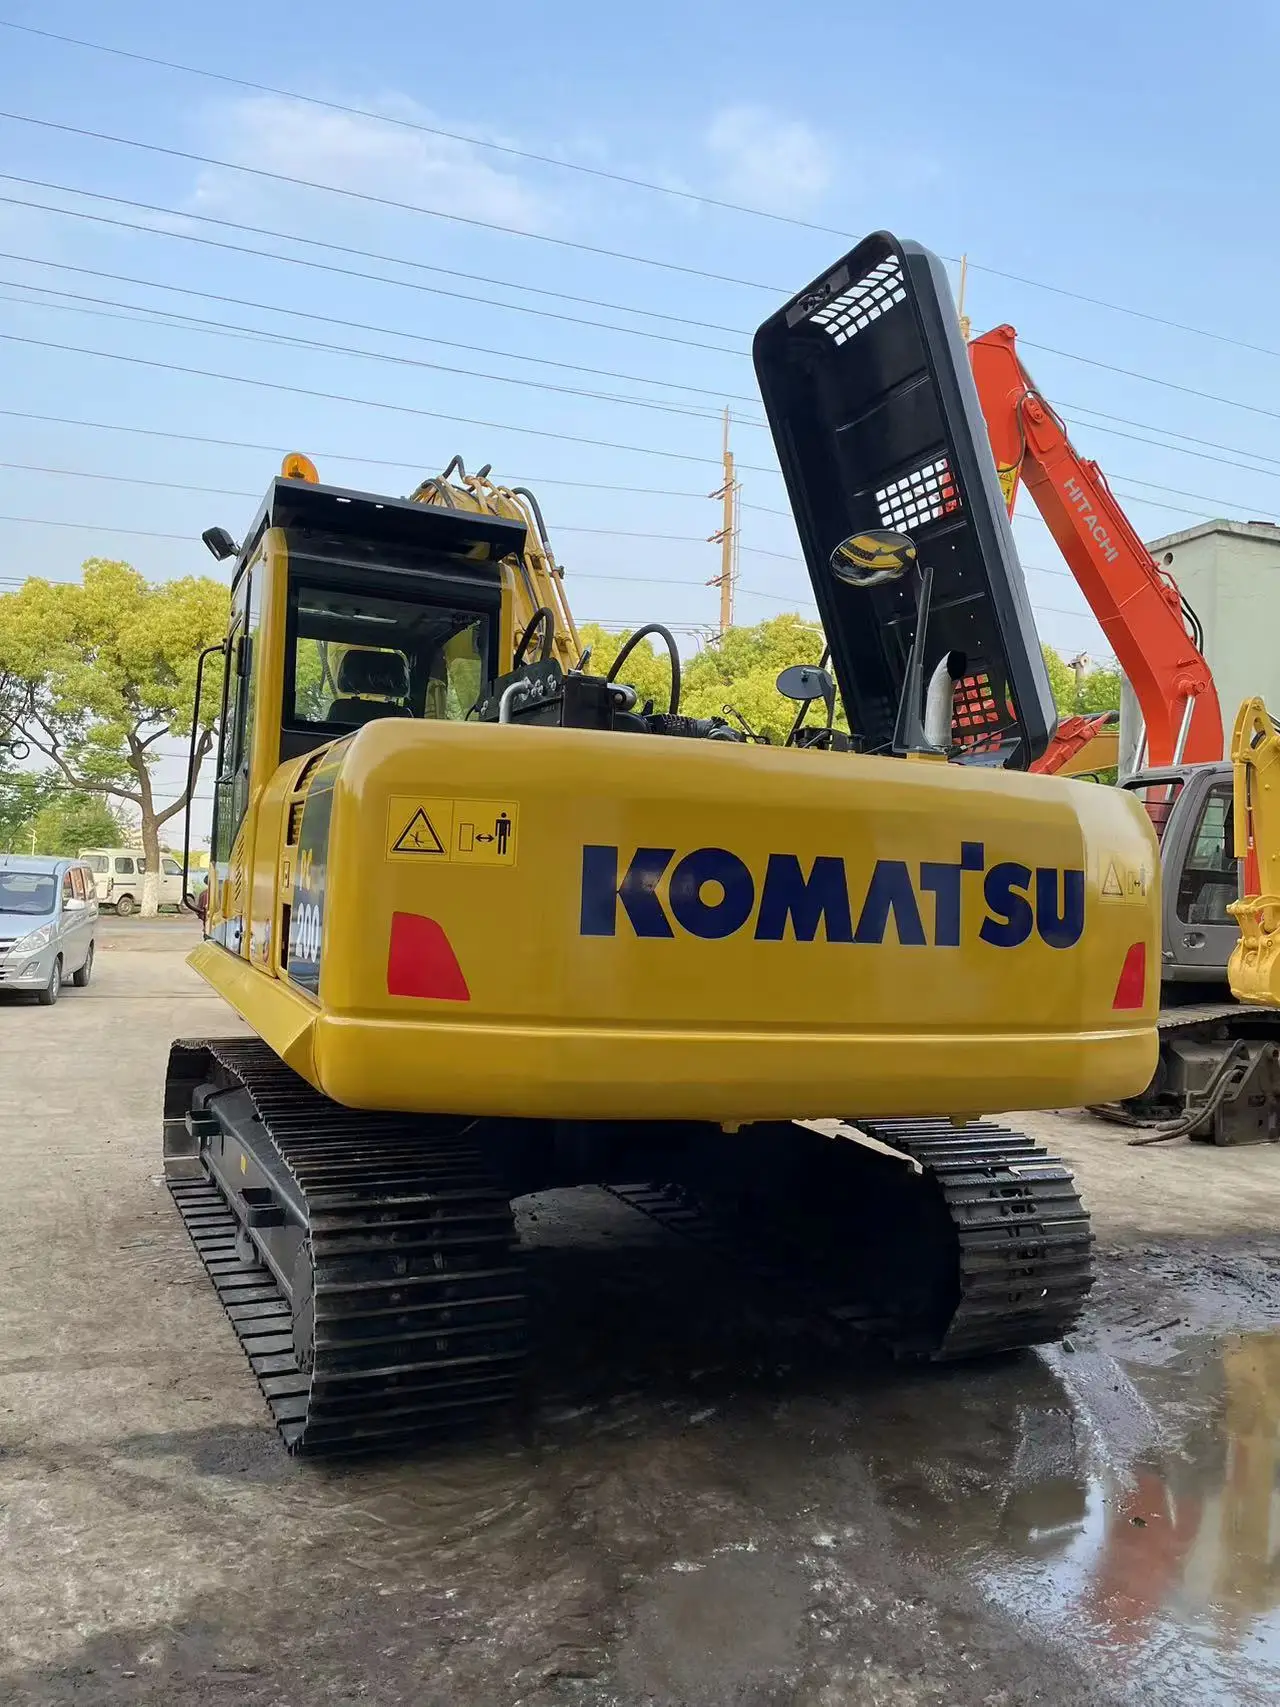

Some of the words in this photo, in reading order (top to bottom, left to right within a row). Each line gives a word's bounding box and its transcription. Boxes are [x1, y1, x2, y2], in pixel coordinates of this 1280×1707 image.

[1063, 477, 1119, 562] HITACHI
[295, 902, 320, 963] 200
[580, 841, 1084, 949] KOMATSU
